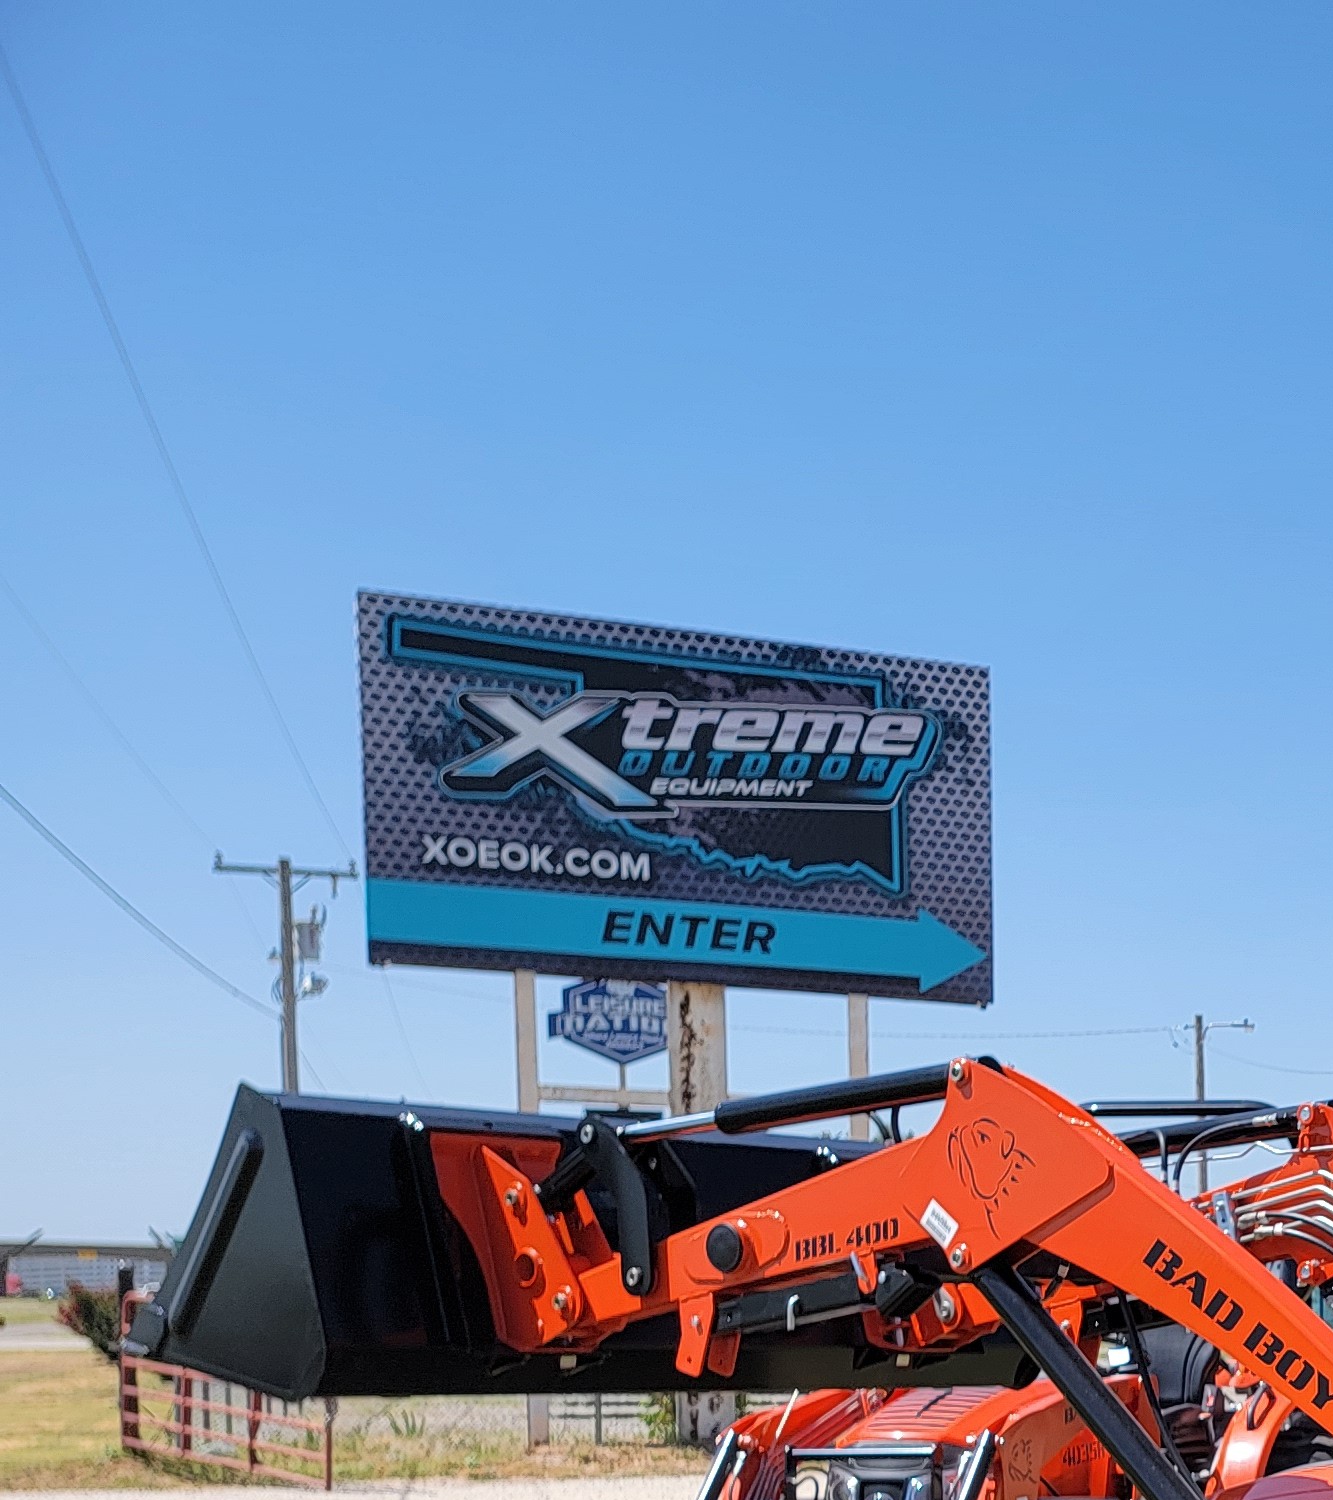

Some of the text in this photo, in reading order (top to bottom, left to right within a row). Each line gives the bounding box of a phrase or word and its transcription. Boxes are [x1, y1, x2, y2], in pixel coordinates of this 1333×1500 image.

[449, 694, 926, 807] Xtreme
[617, 750, 893, 783] OUTDOOR
[649, 778, 813, 798] EQUIPMENT
[421, 834, 652, 882] XOEOK.COM
[601, 910, 778, 954] ENTER
[846, 1217, 899, 1247] 400
[1142, 1238, 1245, 1332] BAD
